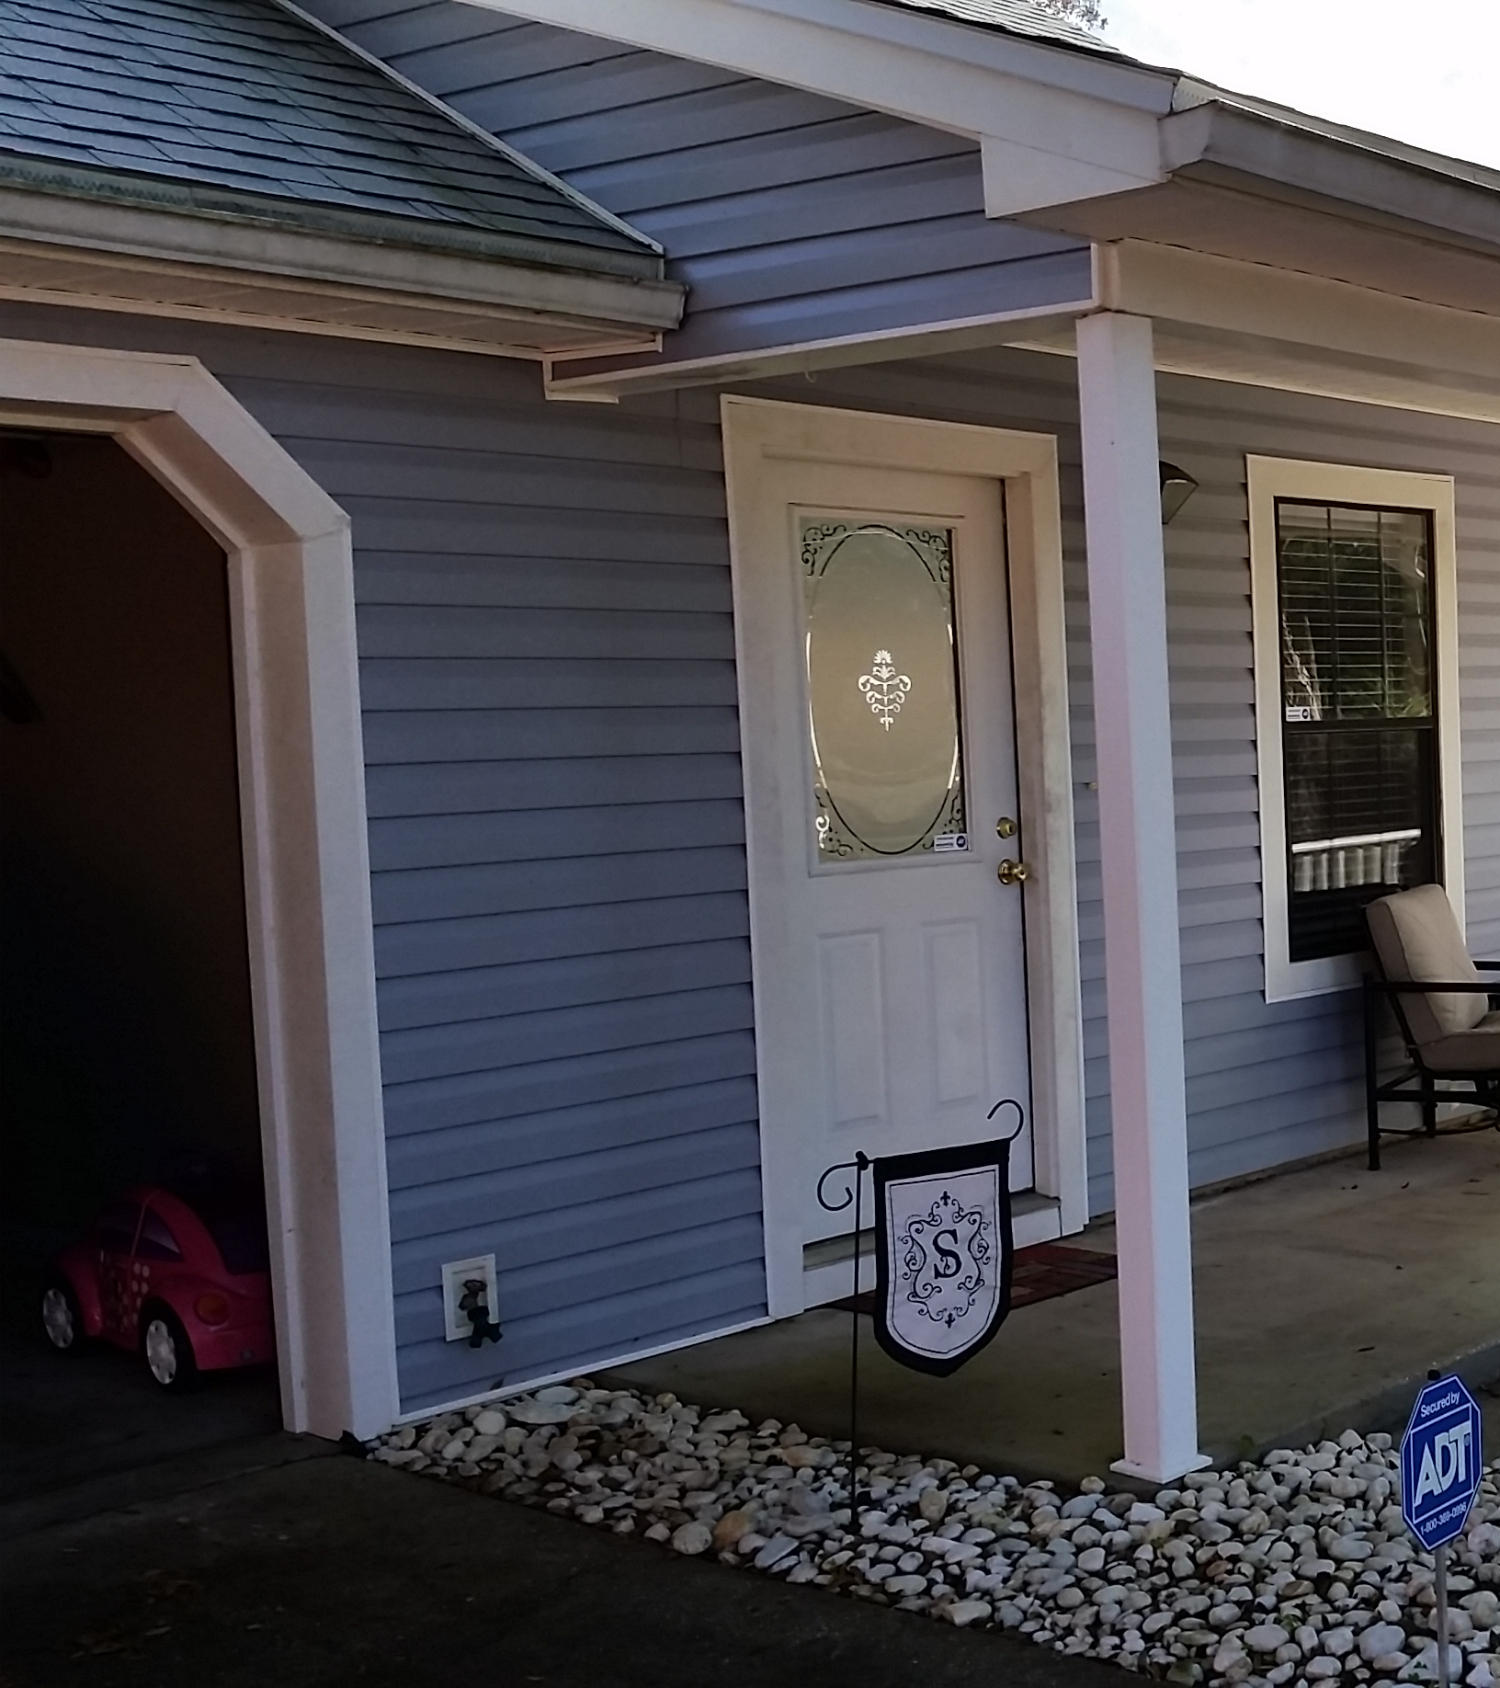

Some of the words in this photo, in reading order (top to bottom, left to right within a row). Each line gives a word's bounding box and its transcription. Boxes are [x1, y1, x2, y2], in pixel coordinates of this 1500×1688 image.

[932, 1228, 963, 1280] S
[1420, 1393, 1450, 1418] Secured
[1450, 1391, 1460, 1405] by
[1413, 1420, 1471, 1508] ADT
